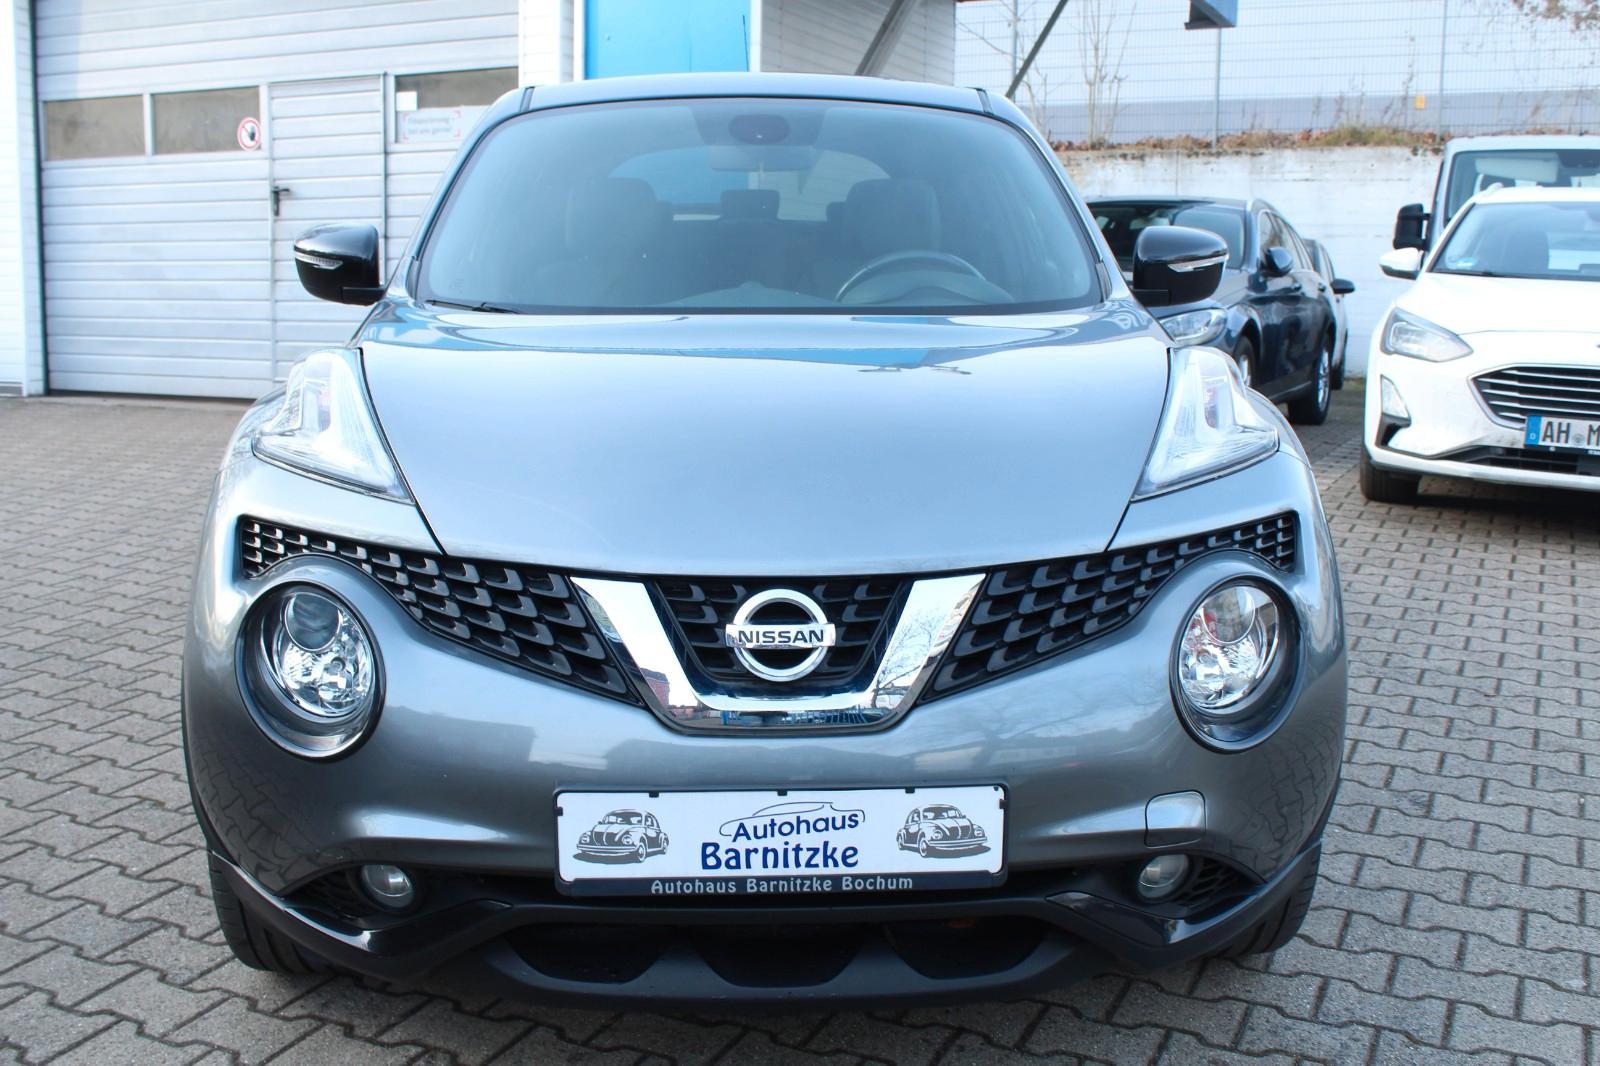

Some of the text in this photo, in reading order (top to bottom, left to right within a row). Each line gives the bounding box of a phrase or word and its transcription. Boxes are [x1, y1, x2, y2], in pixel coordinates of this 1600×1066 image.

[1542, 420, 1570, 444] AH
[738, 629, 824, 644] NISSAN
[732, 812, 859, 843] Autohaus
[701, 840, 859, 870] Barnitzke
[651, 875, 913, 894] Autohaus Barnitzke Bochum
